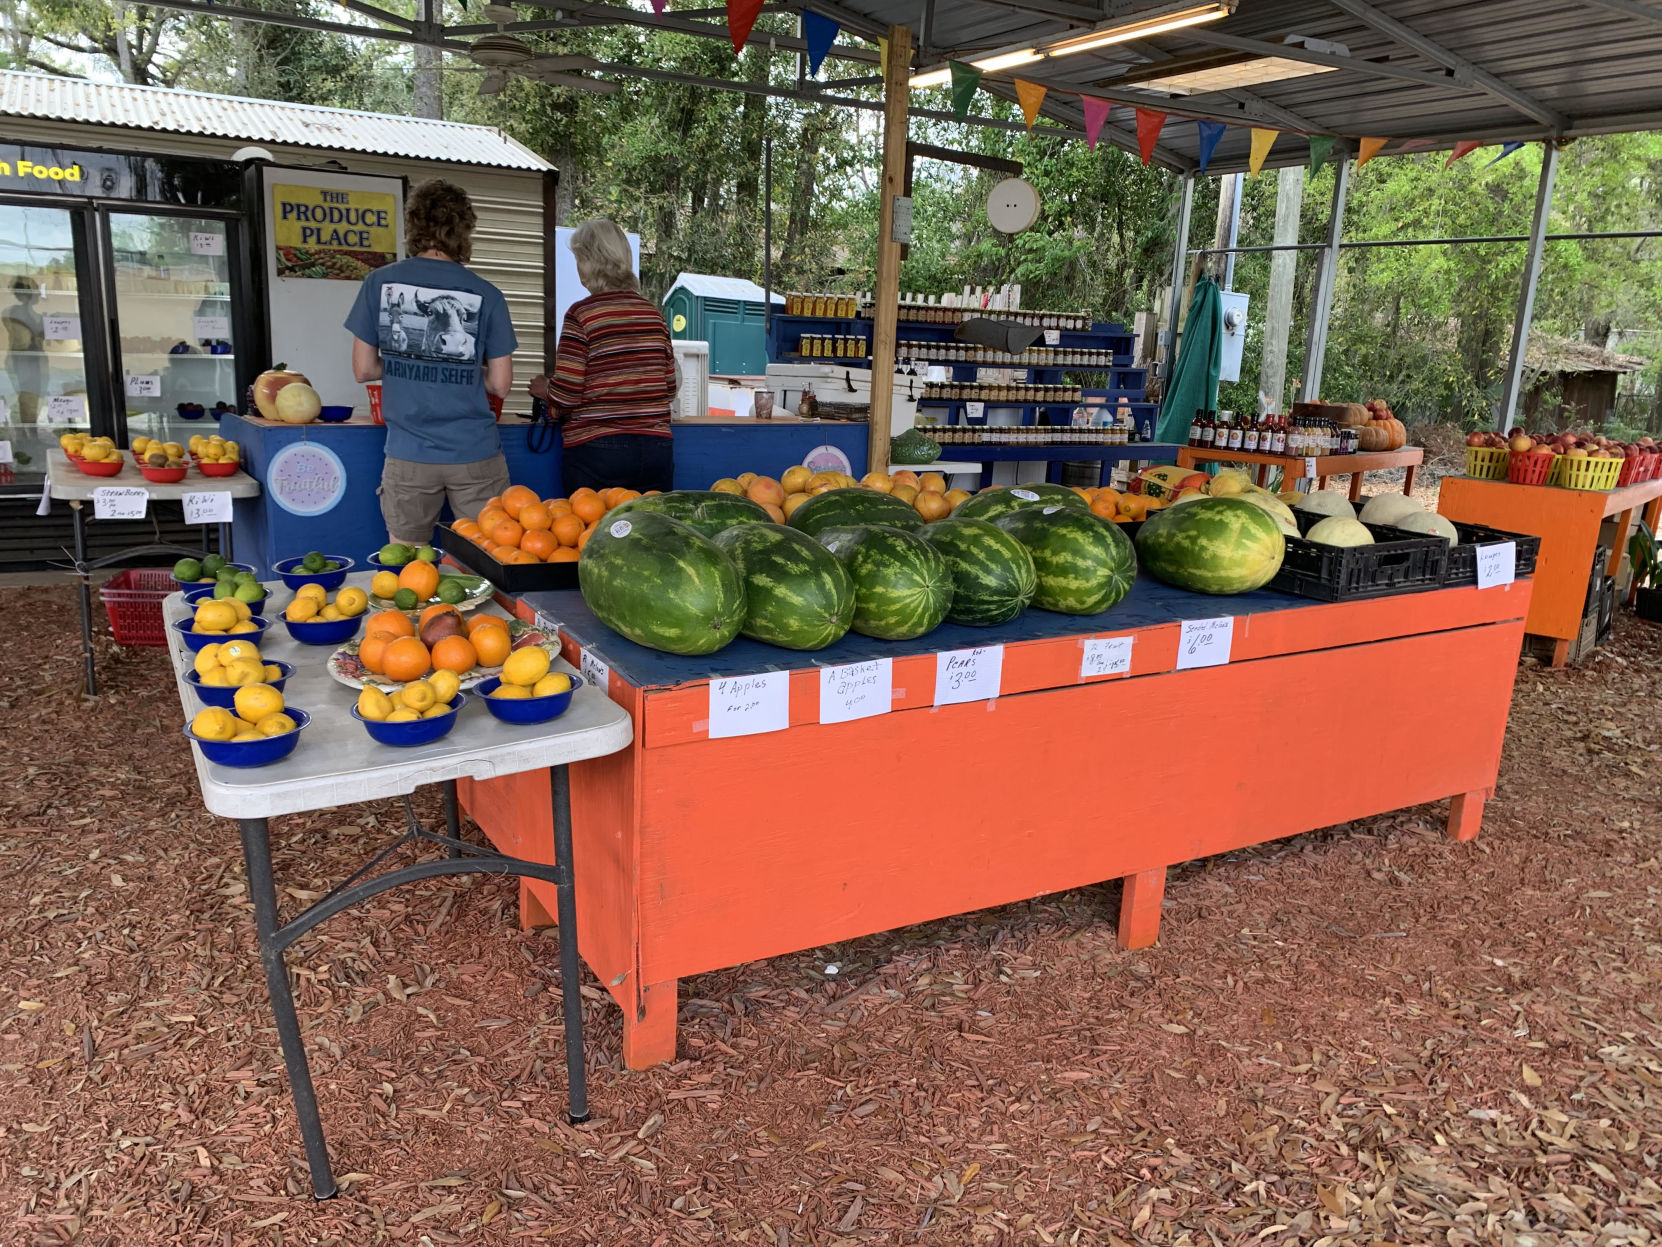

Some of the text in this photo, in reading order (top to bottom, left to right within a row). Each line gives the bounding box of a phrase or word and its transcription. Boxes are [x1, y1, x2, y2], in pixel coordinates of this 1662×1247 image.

[17, 160, 81, 181] Food
[320, 190, 349, 204] THE
[281, 202, 389, 228] PRODUCE
[301, 226, 371, 248] PLACE
[384, 360, 475, 385] ARNYARD SELFIE
[719, 681, 727, 695] 4
